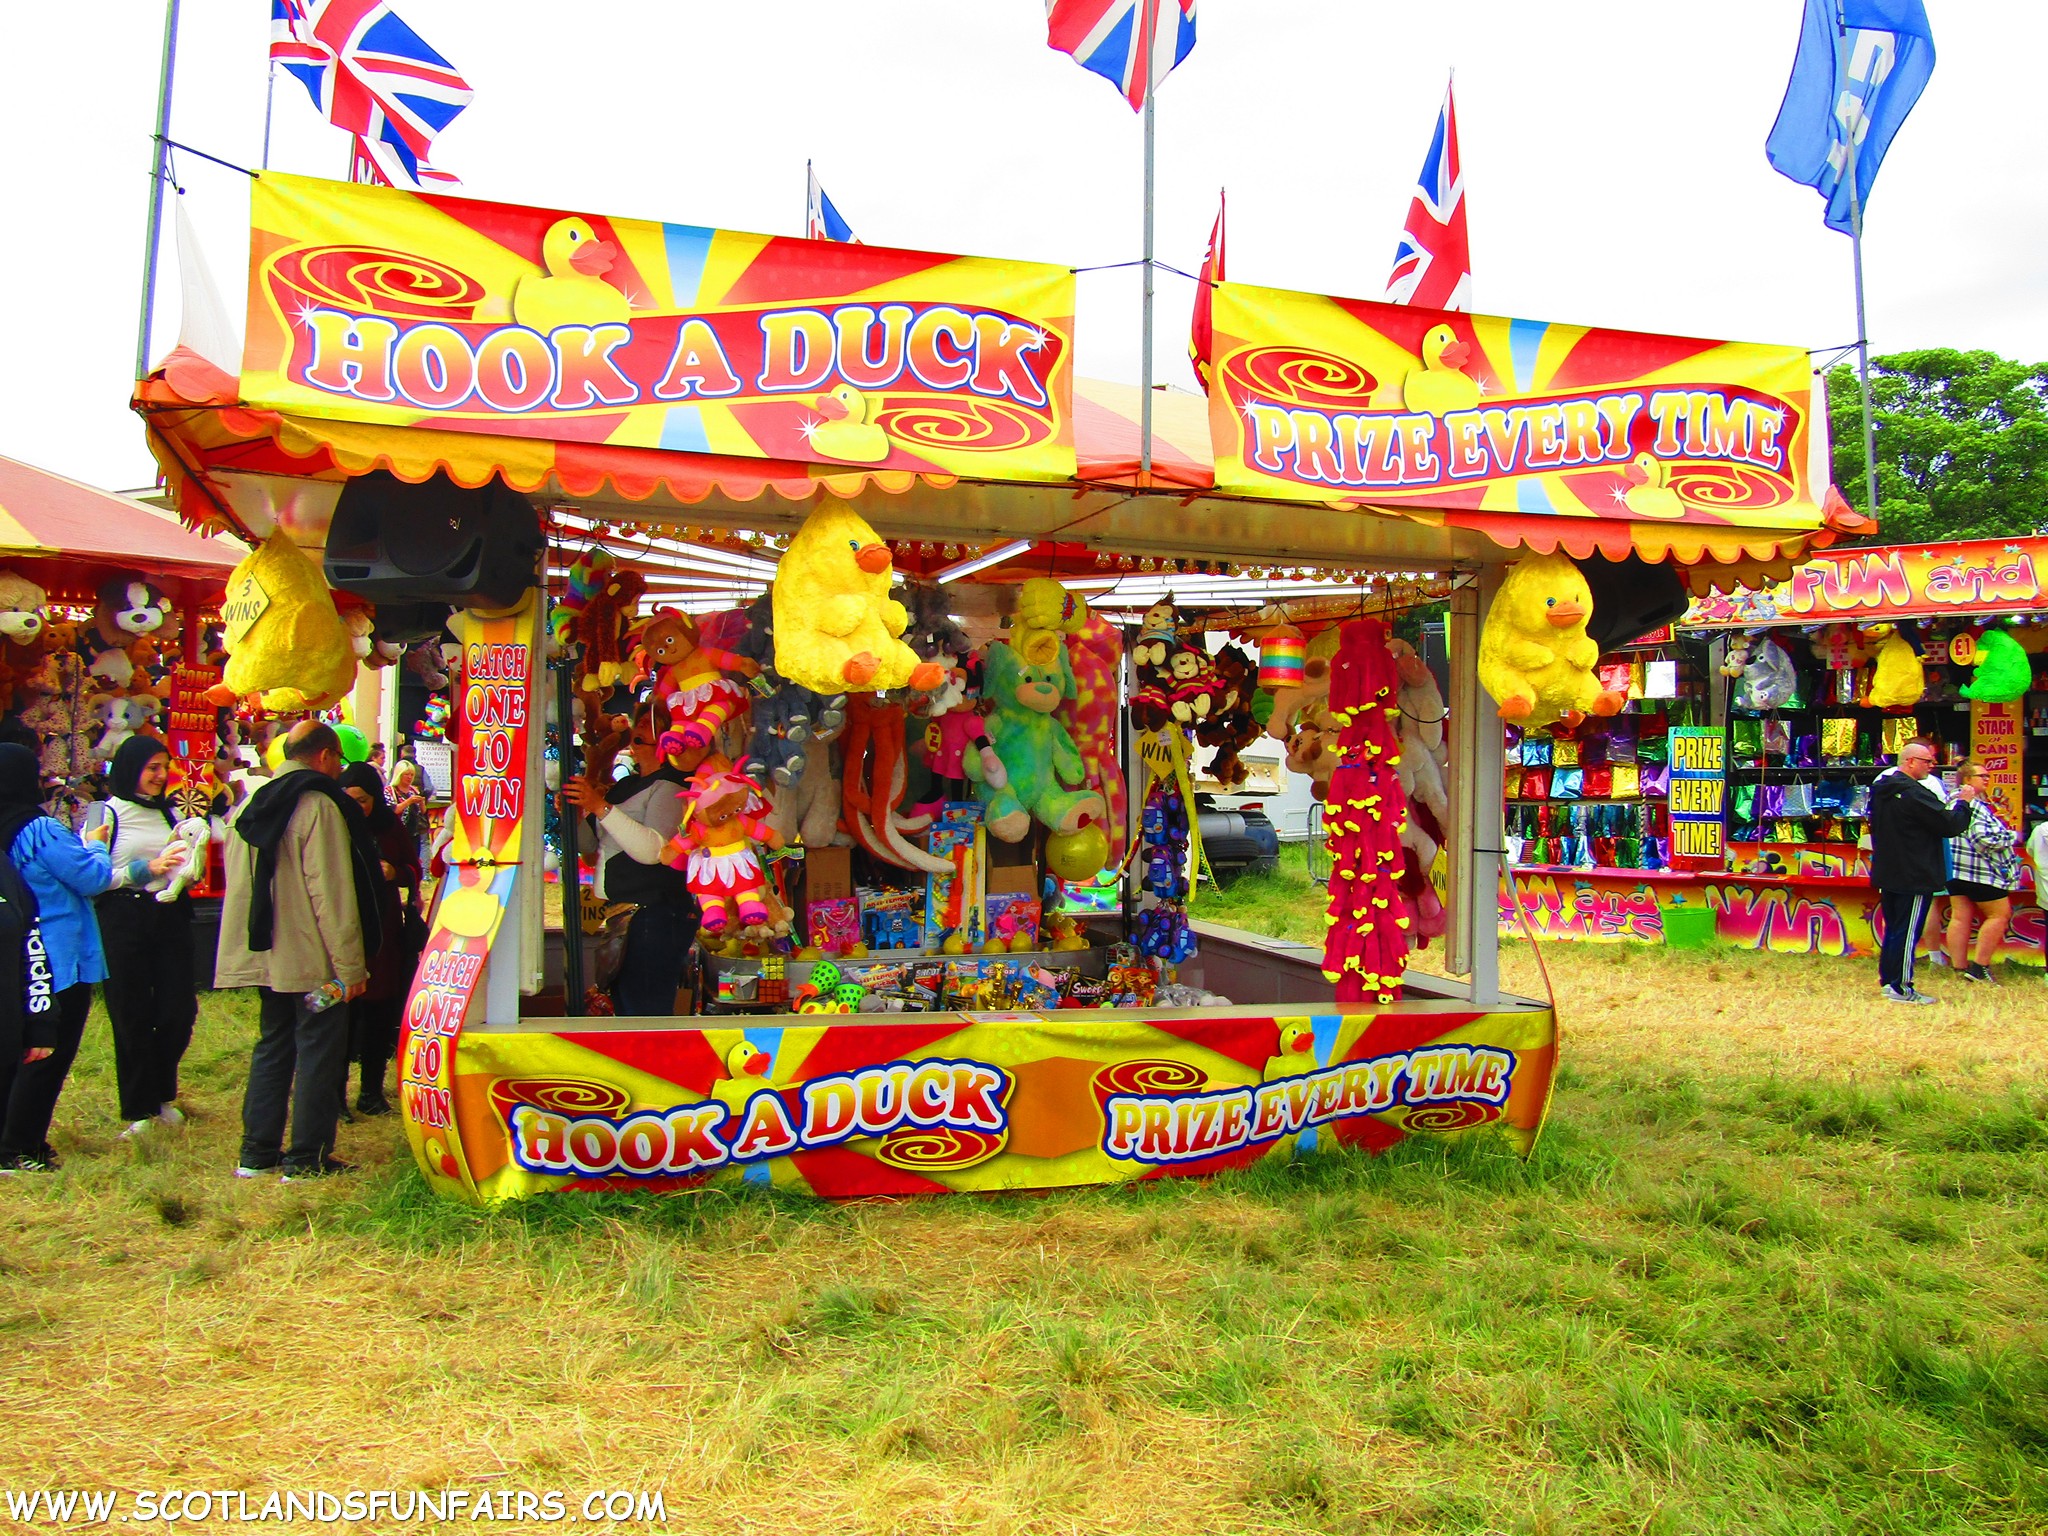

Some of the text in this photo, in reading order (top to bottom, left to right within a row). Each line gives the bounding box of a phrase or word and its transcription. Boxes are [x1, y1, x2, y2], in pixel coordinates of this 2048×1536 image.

[304, 304, 1049, 412] HOOK A DUCK
[1253, 390, 1785, 485] PRIZE EVERY TIME
[242, 579, 252, 596] 3
[1791, 551, 2038, 613] FUN and
[225, 600, 261, 622] WINS
[467, 643, 527, 680] CATCH
[1954, 637, 1970, 657] £1
[176, 668, 216, 688] COME
[170, 711, 215, 731] DARTS
[465, 684, 526, 727] ONE
[1977, 719, 2015, 735] STACK
[472, 730, 511, 772] TO
[1141, 741, 1185, 763] WIN
[1672, 736, 1722, 771] PRIZE
[1976, 744, 2017, 755] CANS
[1986, 758, 2007, 770] OFF
[1670, 778, 1725, 814] EVERY
[1993, 773, 2018, 784] TABLE
[462, 775, 521, 819] WIN
[1671, 820, 1722, 857] TIME!
[583, 888, 592, 901] 2
[1573, 884, 1661, 916] and
[582, 905, 606, 921] INS
[1499, 910, 1665, 945] AMES
[422, 949, 480, 988] CATCH
[409, 989, 465, 1036] ONE
[411, 1035, 441, 1081] TO
[402, 1081, 452, 1131] WIN
[512, 1062, 1004, 1173] HOOK A DUCK
[1108, 1048, 1510, 1160] PRIZE EVERY TIME
